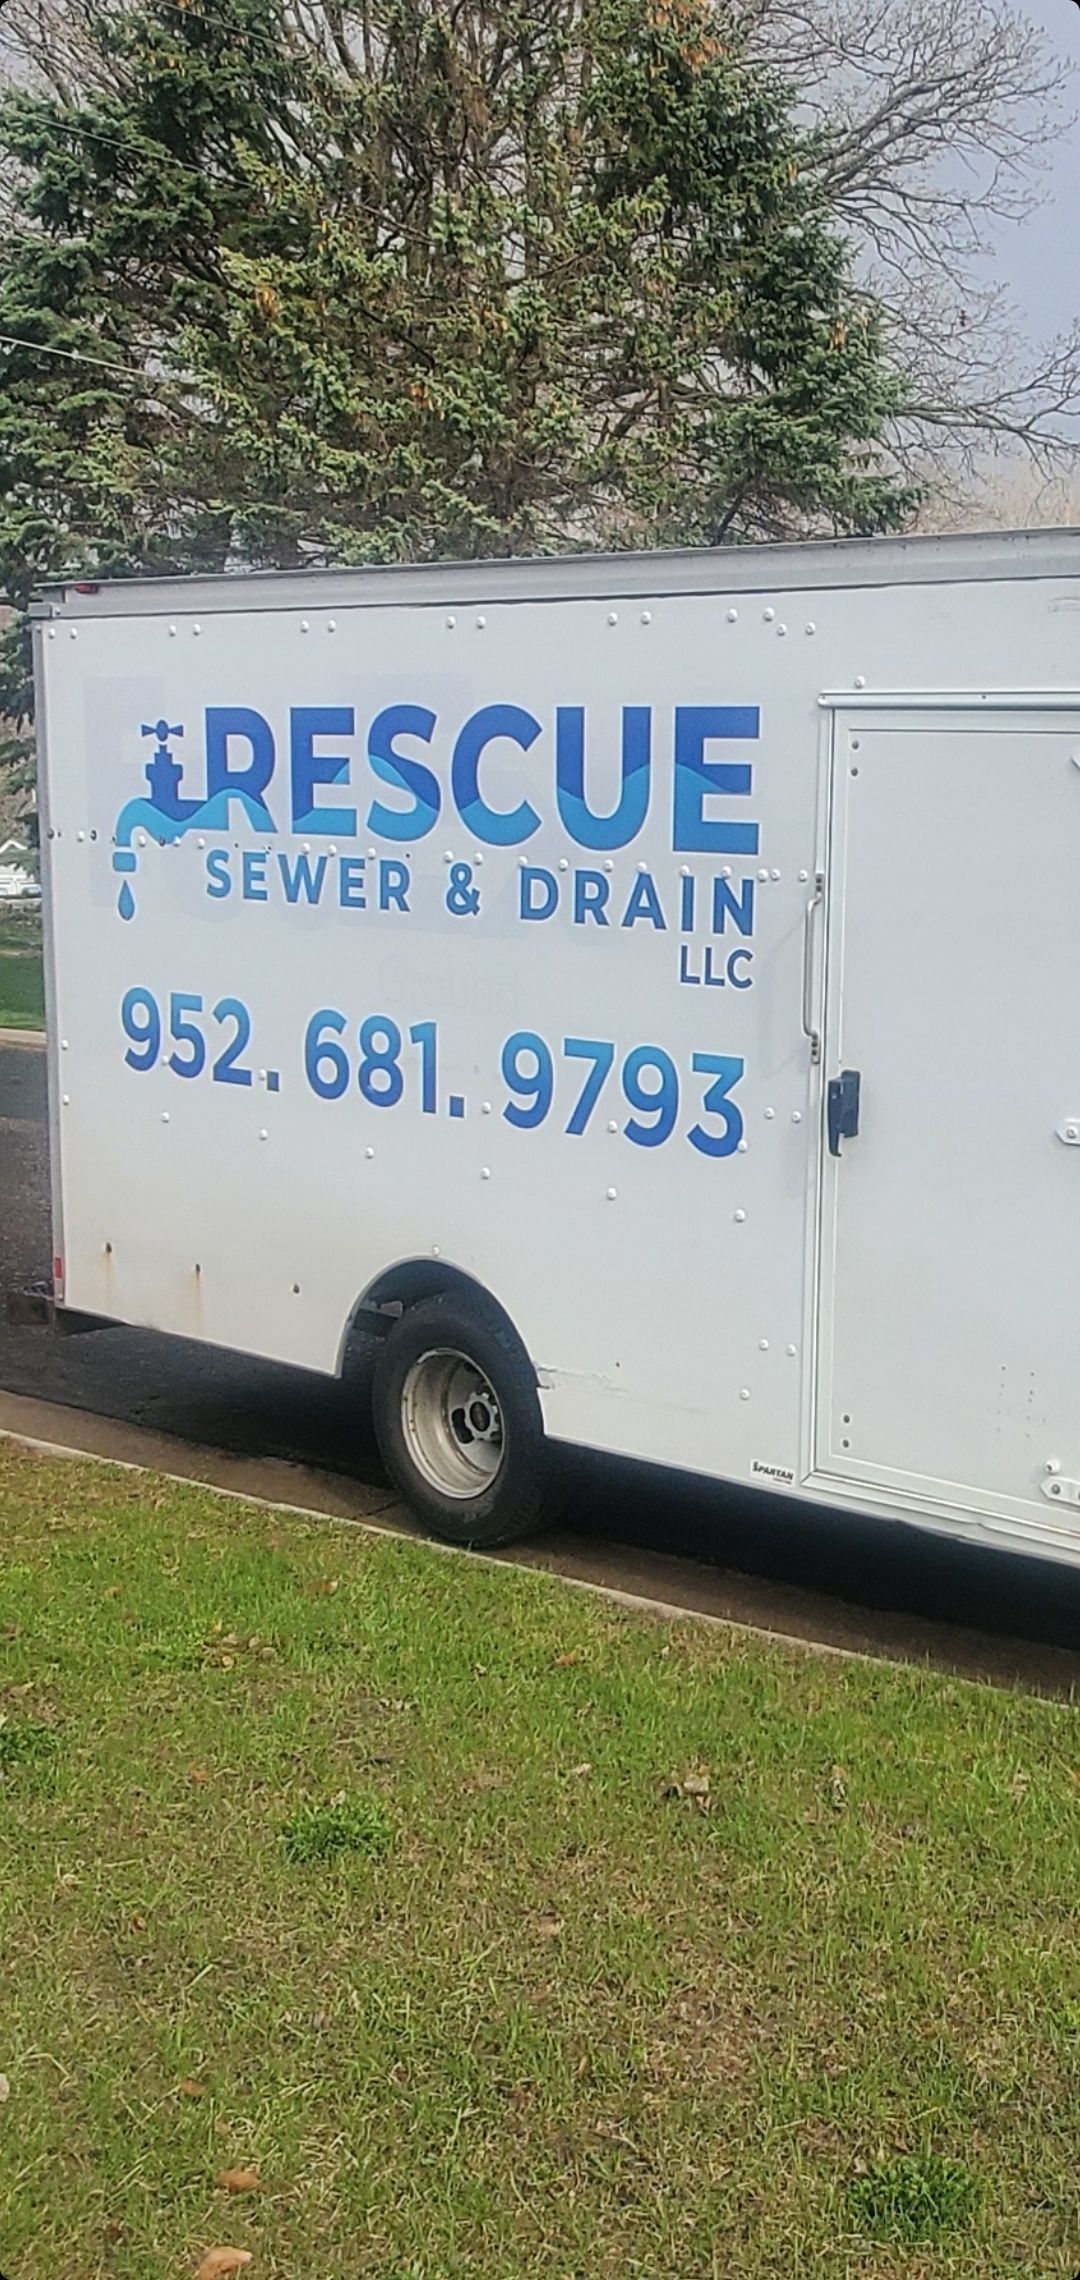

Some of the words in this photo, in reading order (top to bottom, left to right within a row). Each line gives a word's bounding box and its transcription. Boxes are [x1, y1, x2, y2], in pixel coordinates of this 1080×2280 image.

[204, 701, 761, 855] RESCUE
[204, 847, 412, 912] SEWER
[443, 861, 480, 916] &
[517, 865, 755, 937] DRAIN
[678, 944, 753, 988] LLC
[121, 986, 280, 1091] 952.
[304, 1008, 465, 1118] 681.
[499, 1029, 745, 1158] 9793
[752, 1461, 794, 1480] SPARTAN
